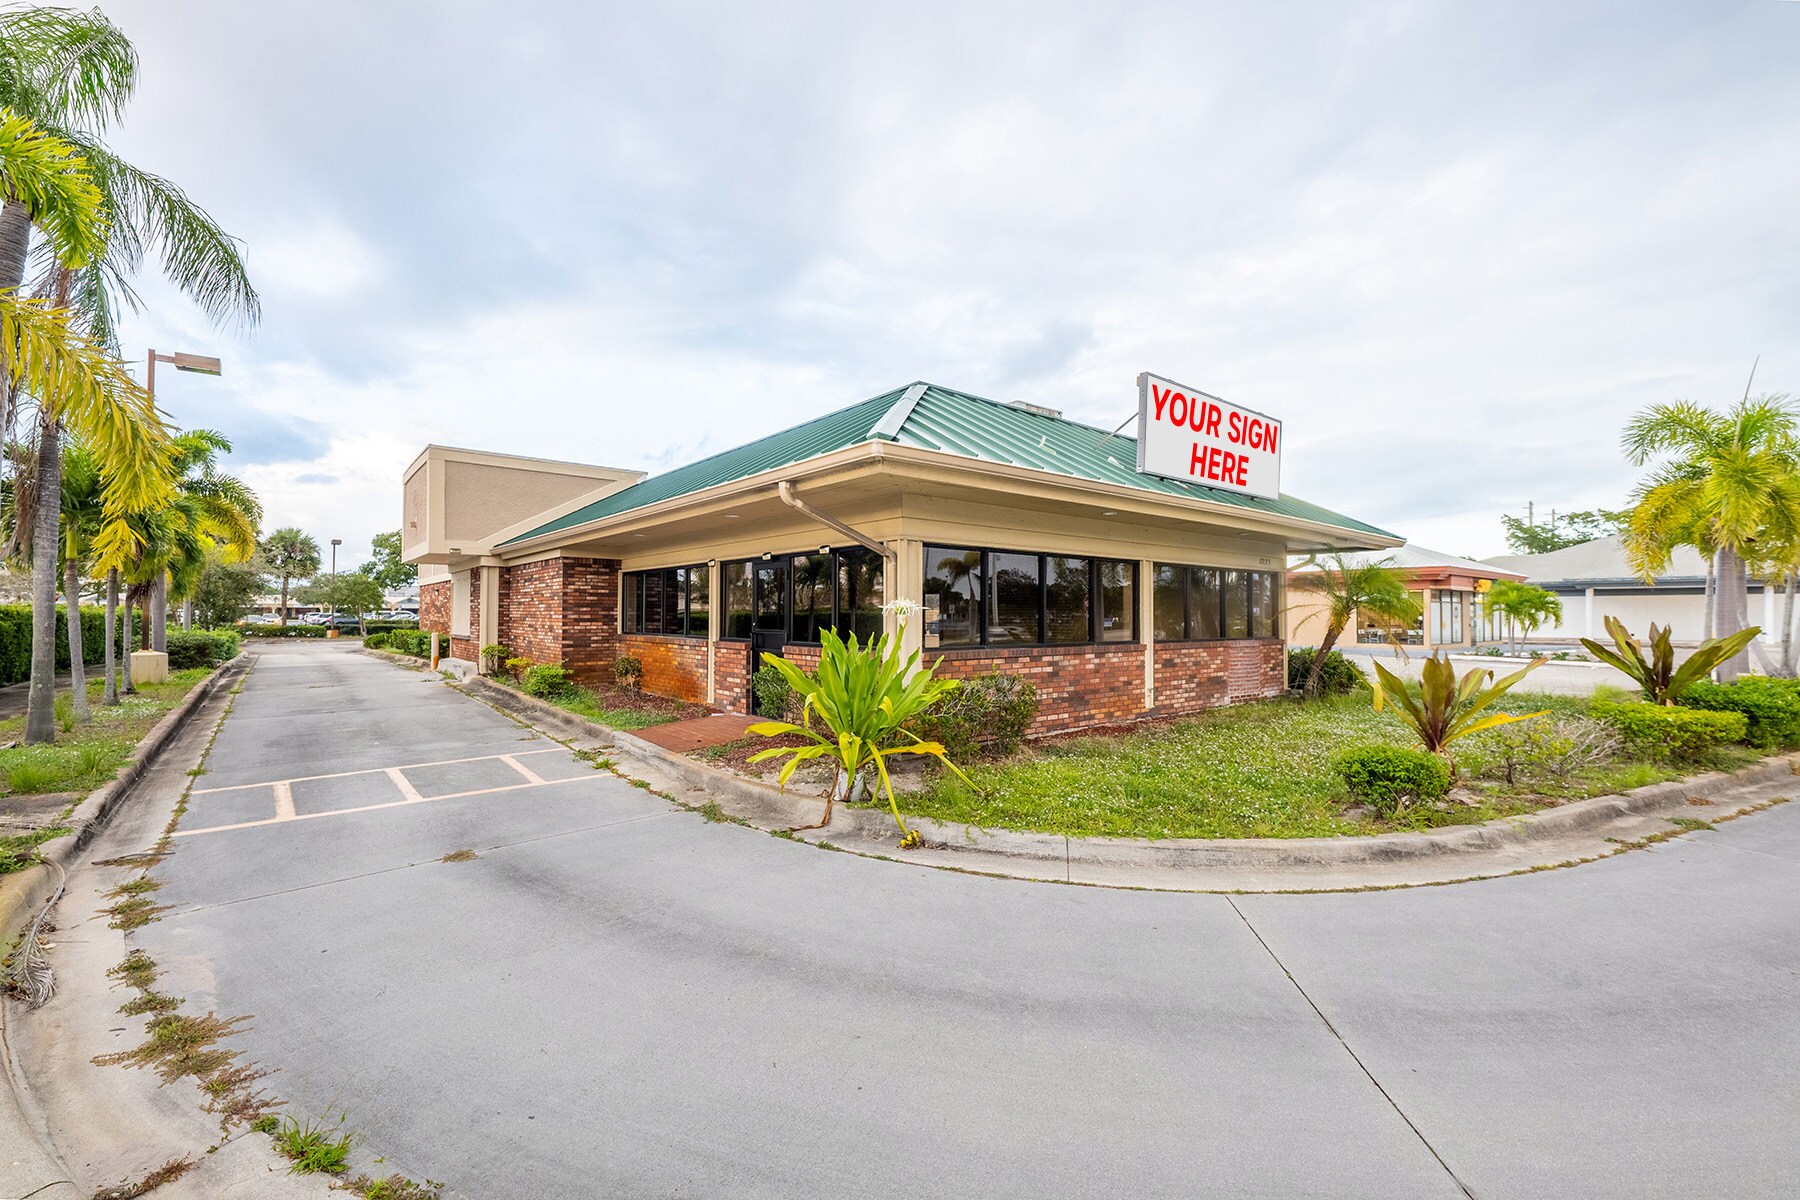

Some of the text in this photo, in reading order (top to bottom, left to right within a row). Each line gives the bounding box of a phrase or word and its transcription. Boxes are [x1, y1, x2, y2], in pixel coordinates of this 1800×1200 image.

[1151, 383, 1278, 455] YOUR SIGN
[1189, 442, 1249, 487] HERE
